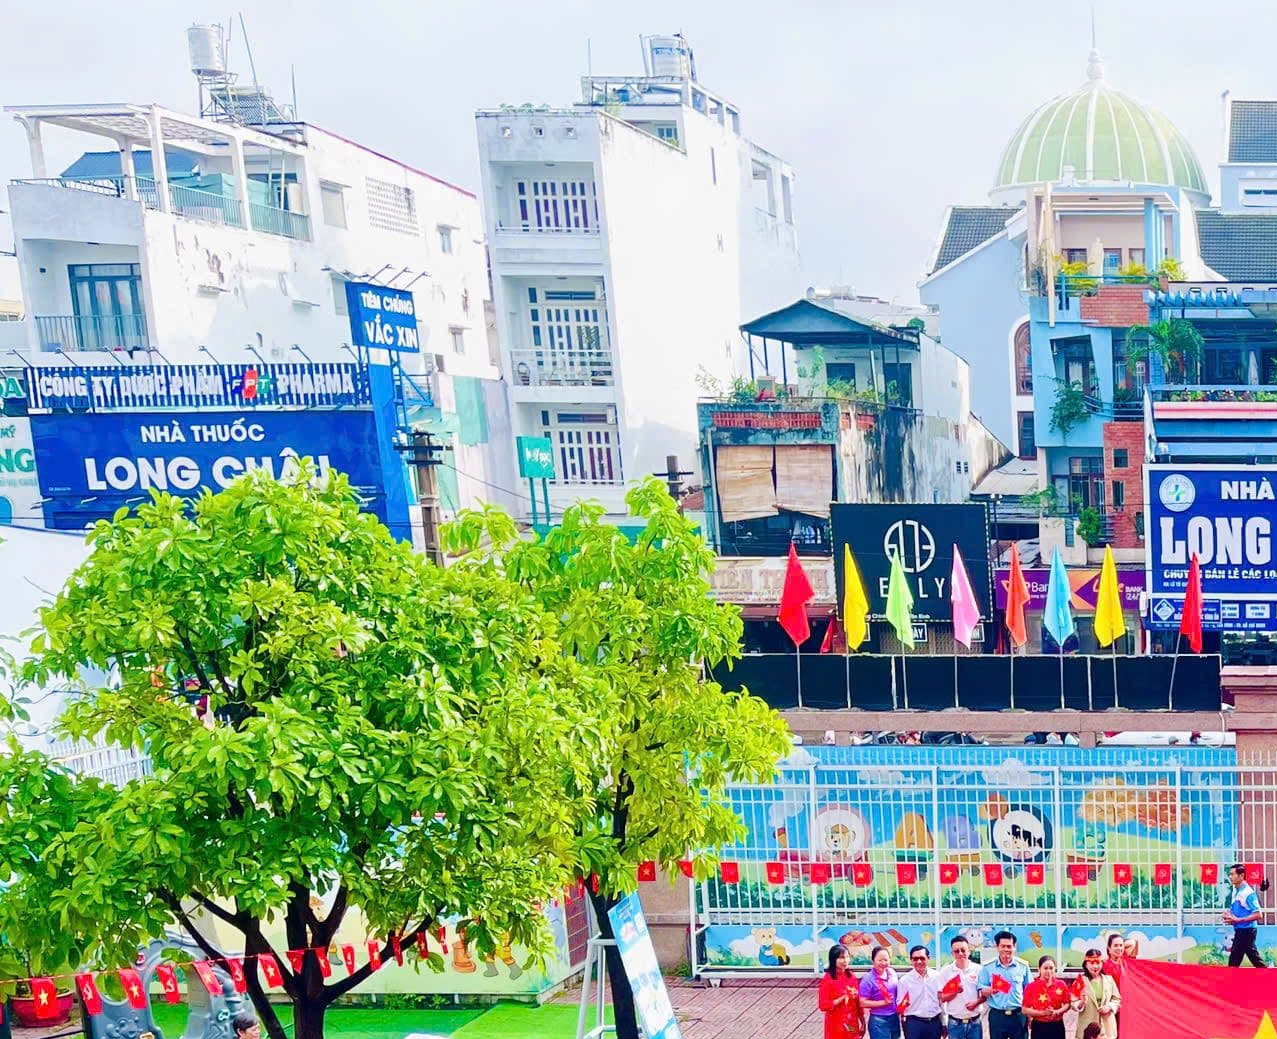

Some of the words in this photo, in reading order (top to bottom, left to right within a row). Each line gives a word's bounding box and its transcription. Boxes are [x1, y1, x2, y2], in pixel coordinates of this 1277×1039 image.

[361, 290, 382, 309] TIÊM
[365, 314, 393, 345] VẮC
[397, 326, 418, 348] XIN
[40, 373, 88, 397] CÔNG
[91, 376, 115, 399] TY
[231, 376, 270, 394] FPT
[276, 374, 354, 394] PHARMA
[140, 420, 186, 443] NHÀ
[190, 417, 265, 443] THUỐC
[85, 457, 200, 490] LONG
[1221, 477, 1275, 500] NHÀ
[1160, 516, 1272, 565] LONG
[879, 577, 945, 598] ELY
